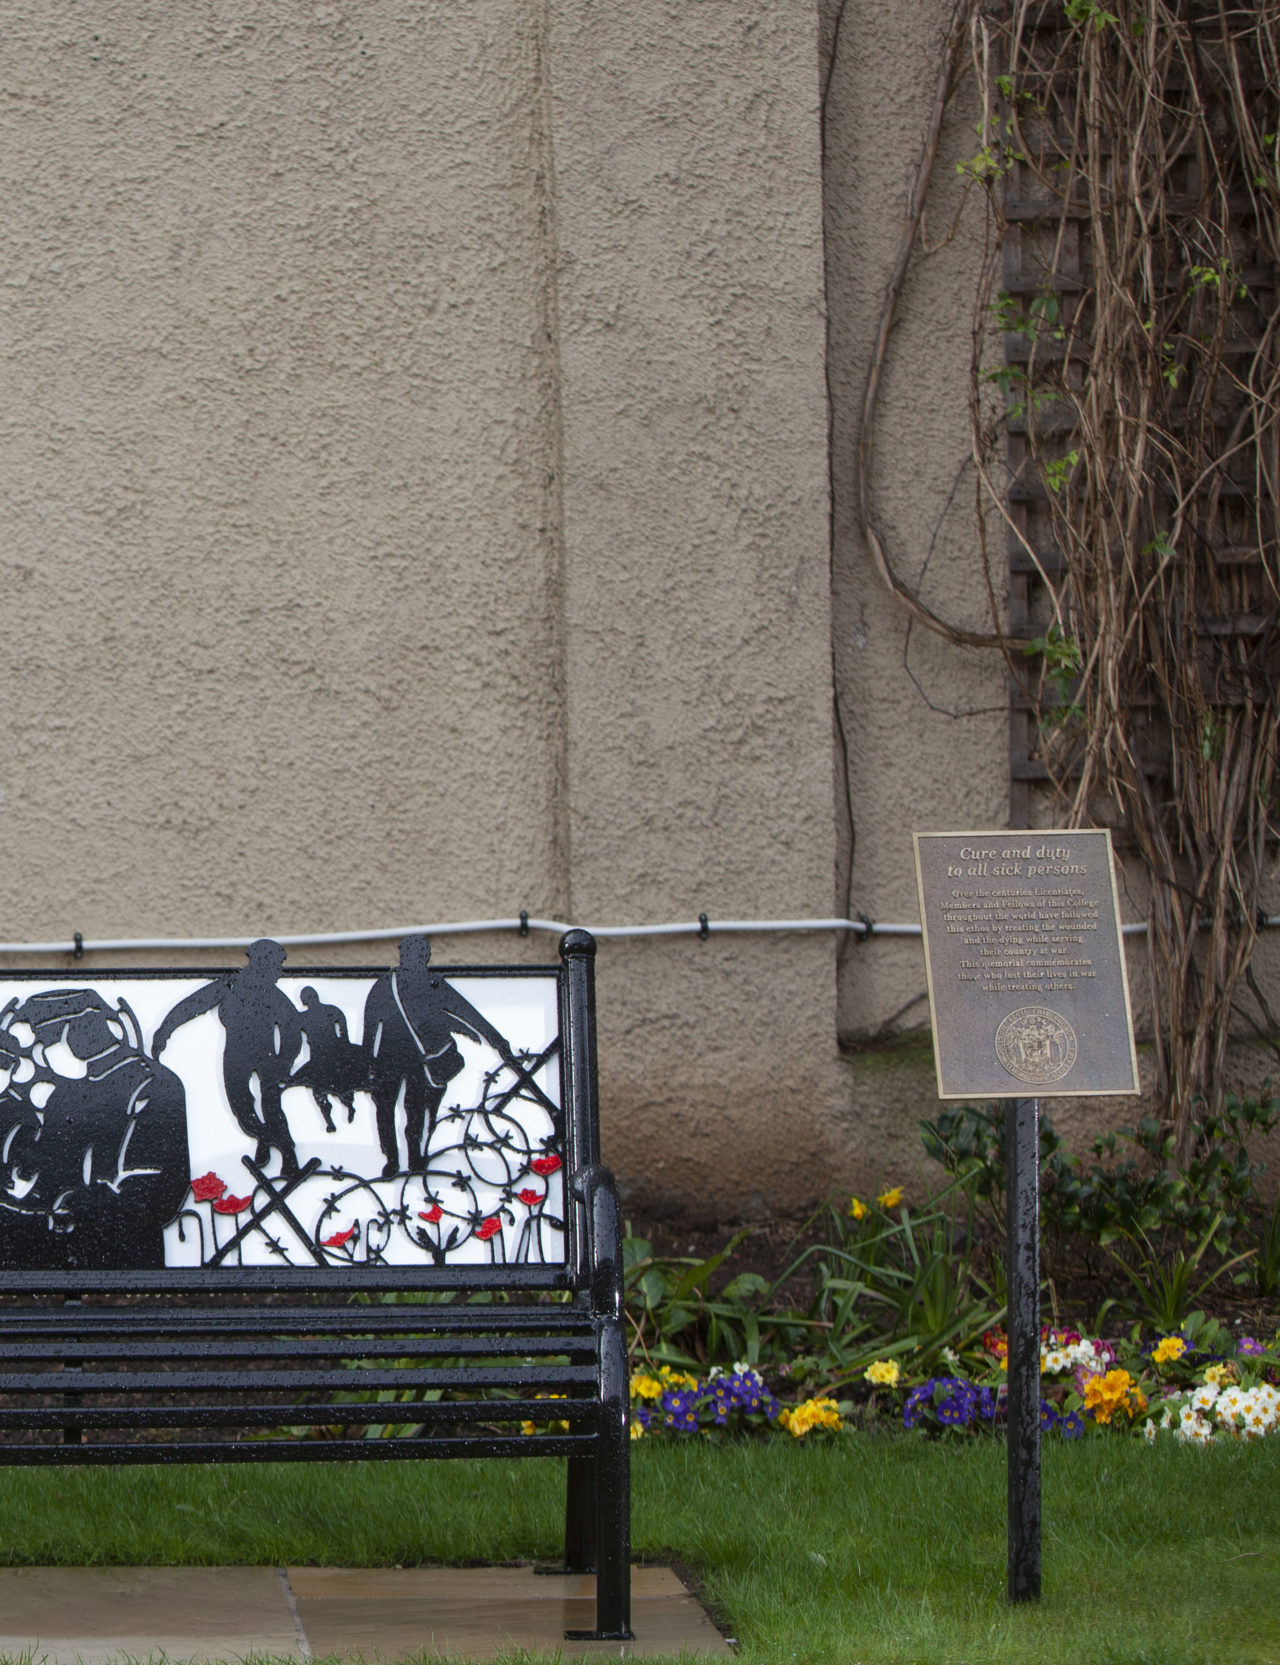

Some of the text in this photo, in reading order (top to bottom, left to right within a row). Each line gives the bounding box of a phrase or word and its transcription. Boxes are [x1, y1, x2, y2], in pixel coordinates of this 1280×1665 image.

[960, 845, 1071, 861] Cure and duty
[947, 863, 1087, 877] to all sick persons
[952, 888, 1085, 898] Over the centuries Licentiates,
[940, 899, 1098, 910] Members and Fellows of this College
[944, 910, 1098, 923] throughout the world have followed
[947, 922, 1097, 934] this ethos by treating the wounded
[963, 934, 1084, 946] and the dying while serving
[980, 947, 1069, 957] their country at war.
[960, 958, 1092, 969] This memorial commemorates
[985, 971, 1002, 980] who
[1004, 970, 1020, 980] lost
[1023, 970, 1044, 979] their
[1046, 970, 1066, 979] lives
[1069, 969, 1078, 978] in
[1080, 970, 1097, 978] war
[982, 982, 1006, 991] while
[1008, 981, 1043, 993] treating
